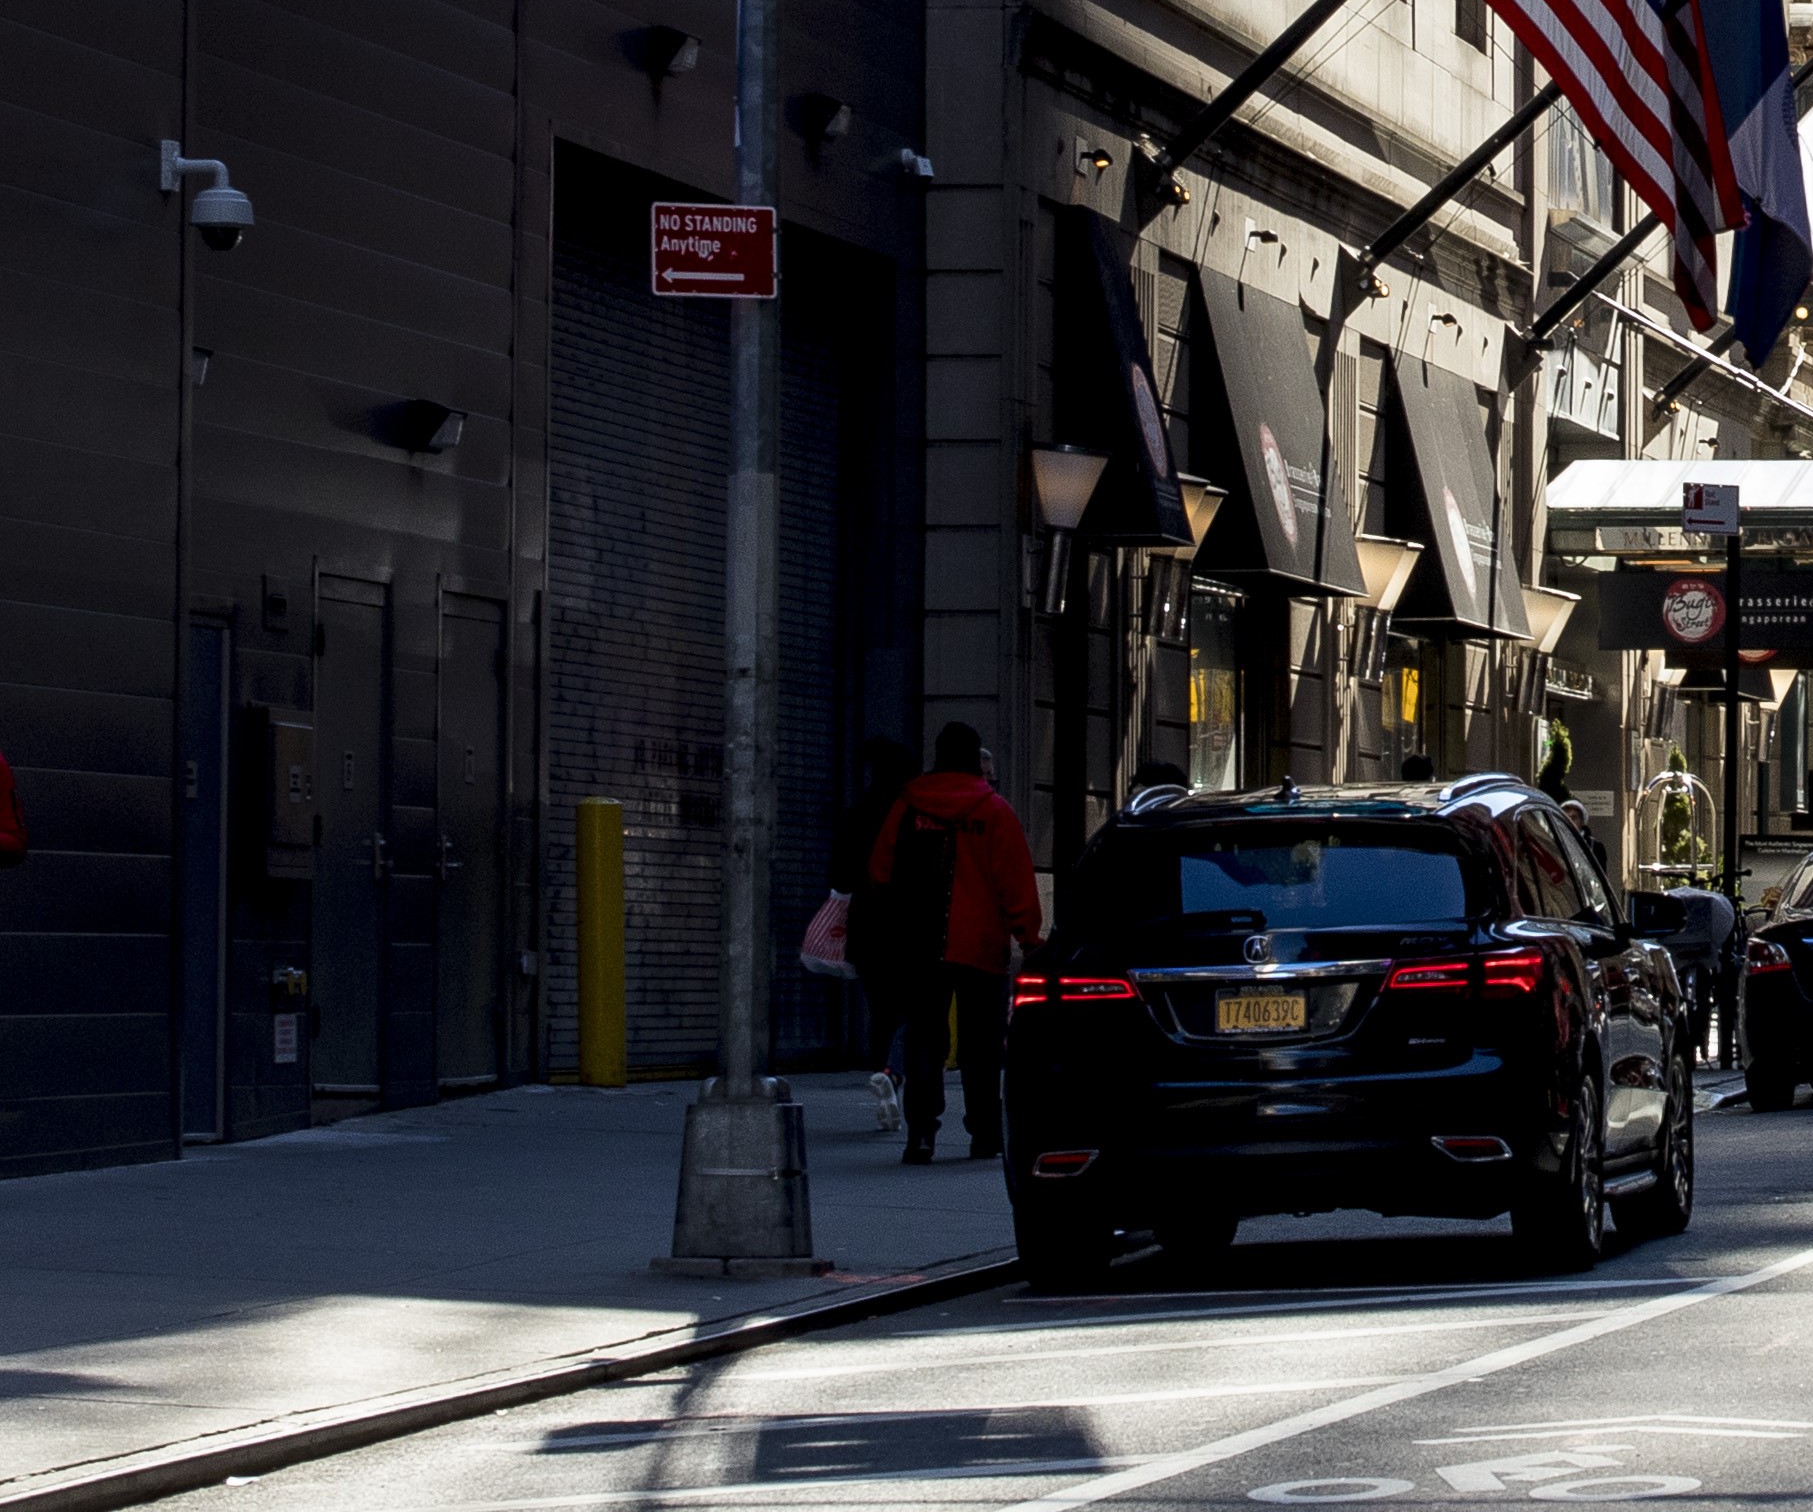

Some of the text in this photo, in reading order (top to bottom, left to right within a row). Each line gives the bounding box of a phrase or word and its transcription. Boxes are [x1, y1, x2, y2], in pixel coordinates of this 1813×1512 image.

[660, 214, 758, 234] NO STANDING
[661, 235, 722, 257] Anytime
[1738, 596, 1807, 607] rasserie
[1741, 615, 1807, 626] ngaporean
[1224, 999, 1300, 1024] T740639C
